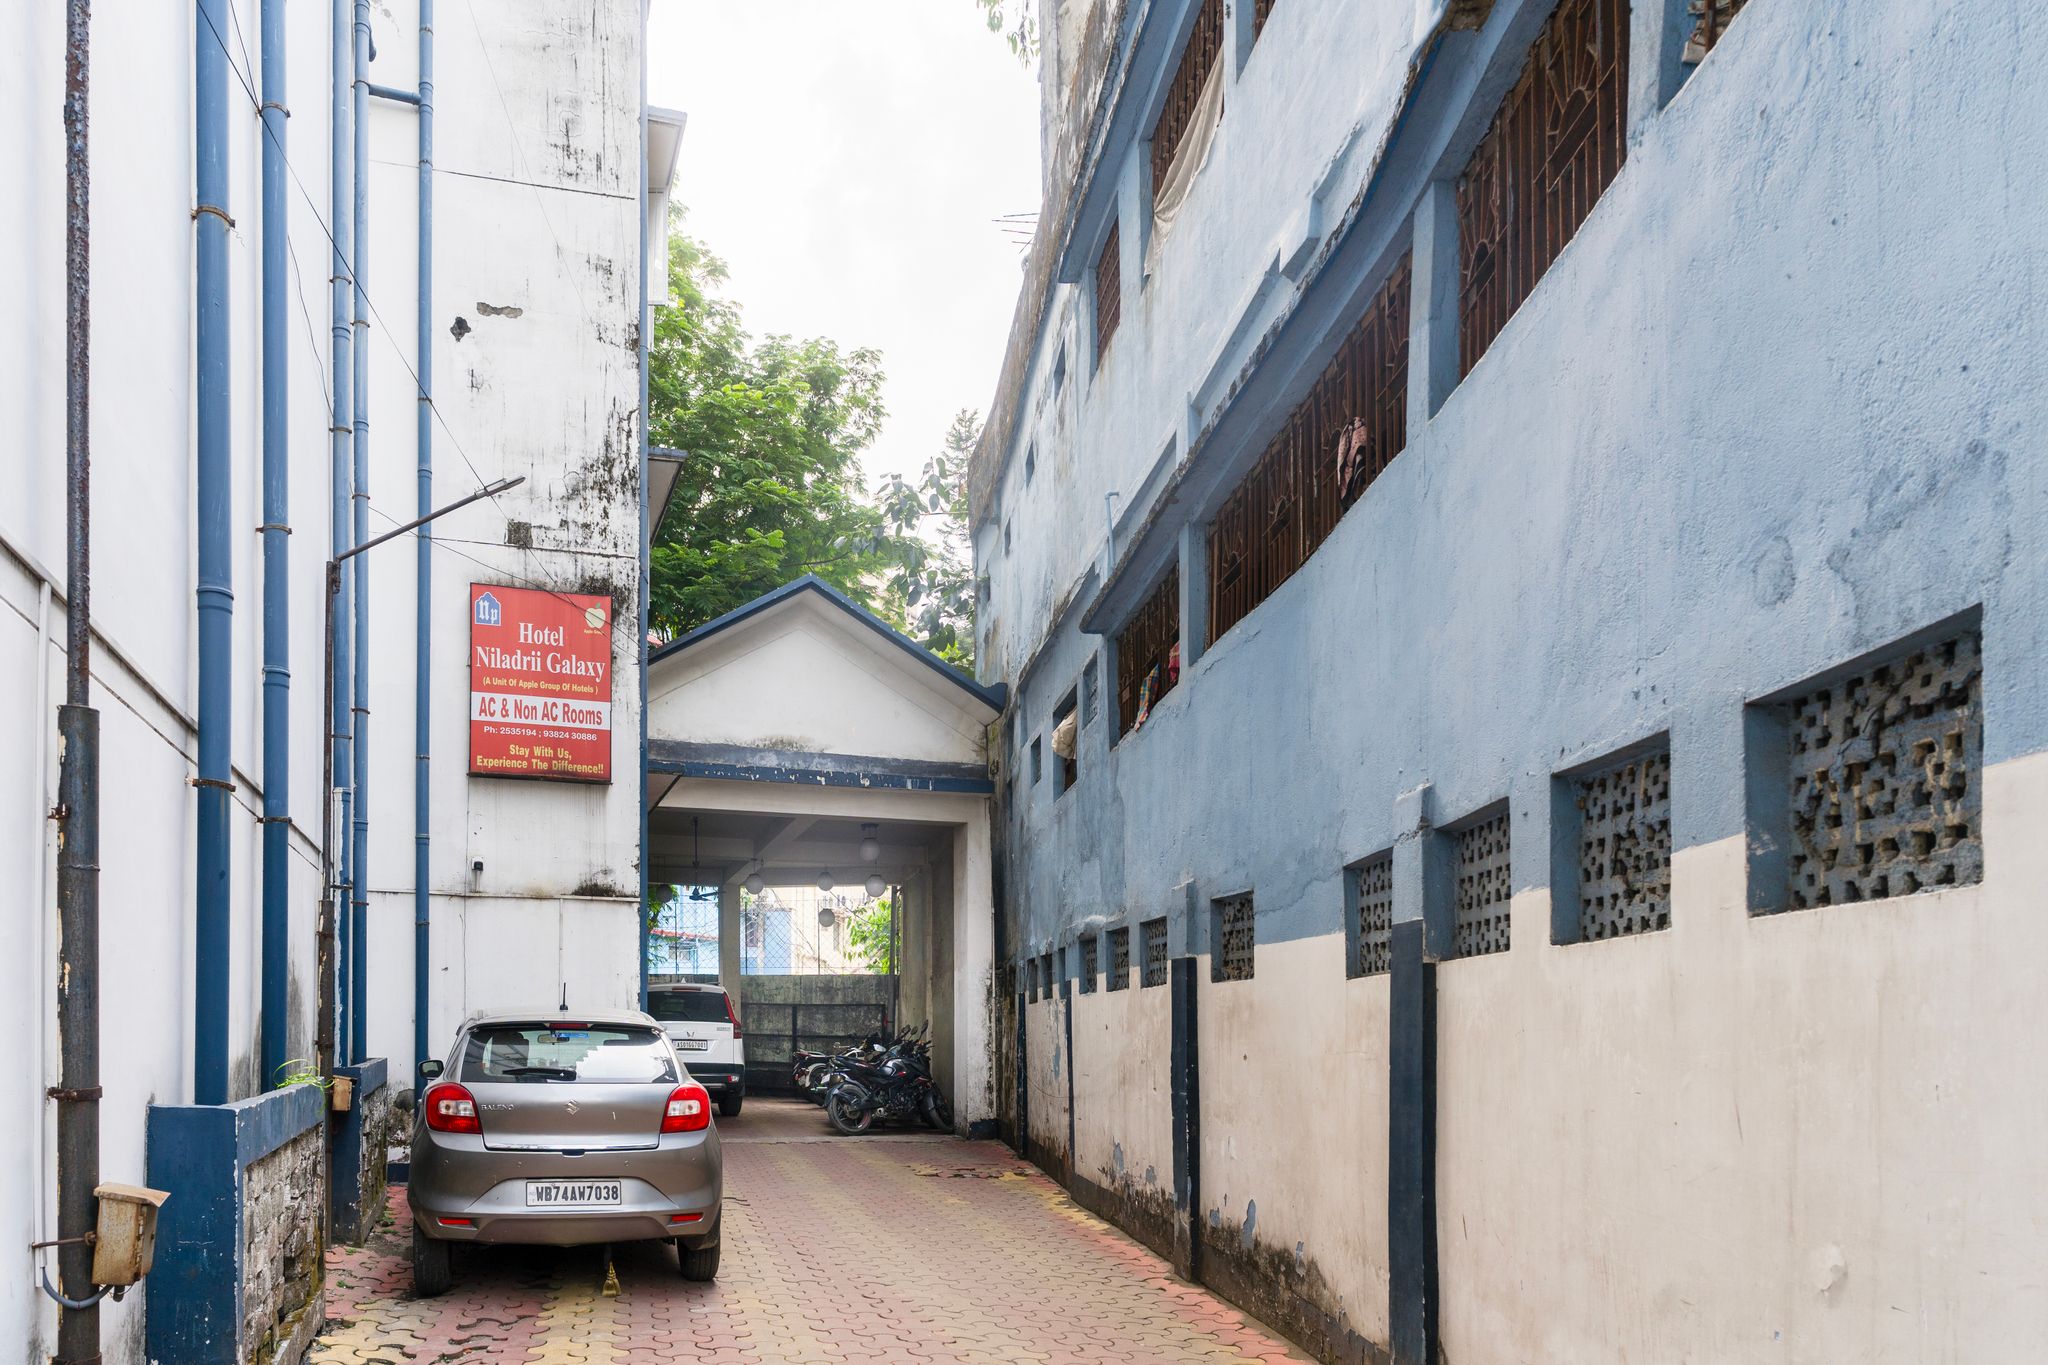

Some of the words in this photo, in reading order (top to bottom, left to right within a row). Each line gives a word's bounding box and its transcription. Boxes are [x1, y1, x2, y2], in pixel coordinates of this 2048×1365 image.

[518, 622, 564, 647] Hotel
[475, 646, 542, 672] Niladrii
[546, 652, 606, 683] Galaxy
[482, 676, 490, 686] (A
[492, 677, 507, 686] Unit
[508, 678, 517, 687] Of
[518, 680, 538, 689] Apple
[540, 681, 560, 692] Group
[562, 682, 570, 691] Of
[572, 682, 594, 693] Hotels
[478, 696, 496, 718] AC
[500, 698, 510, 718] &
[514, 699, 538, 721] Non
[542, 701, 558, 722] AC
[562, 702, 602, 726] Rooms
[484, 726, 498, 734] Ph:
[500, 726, 536, 736] 2535194
[543, 730, 570, 739] 93824
[571, 732, 598, 741] 30886
[510, 744, 530, 758] Stay
[534, 746, 554, 758] With
[558, 748, 572, 760] Us,
[476, 756, 528, 768] Experience
[532, 758, 548, 770] The
[552, 760, 604, 774] Difference!!
[536, 1186, 618, 1202] WB74AW7038
